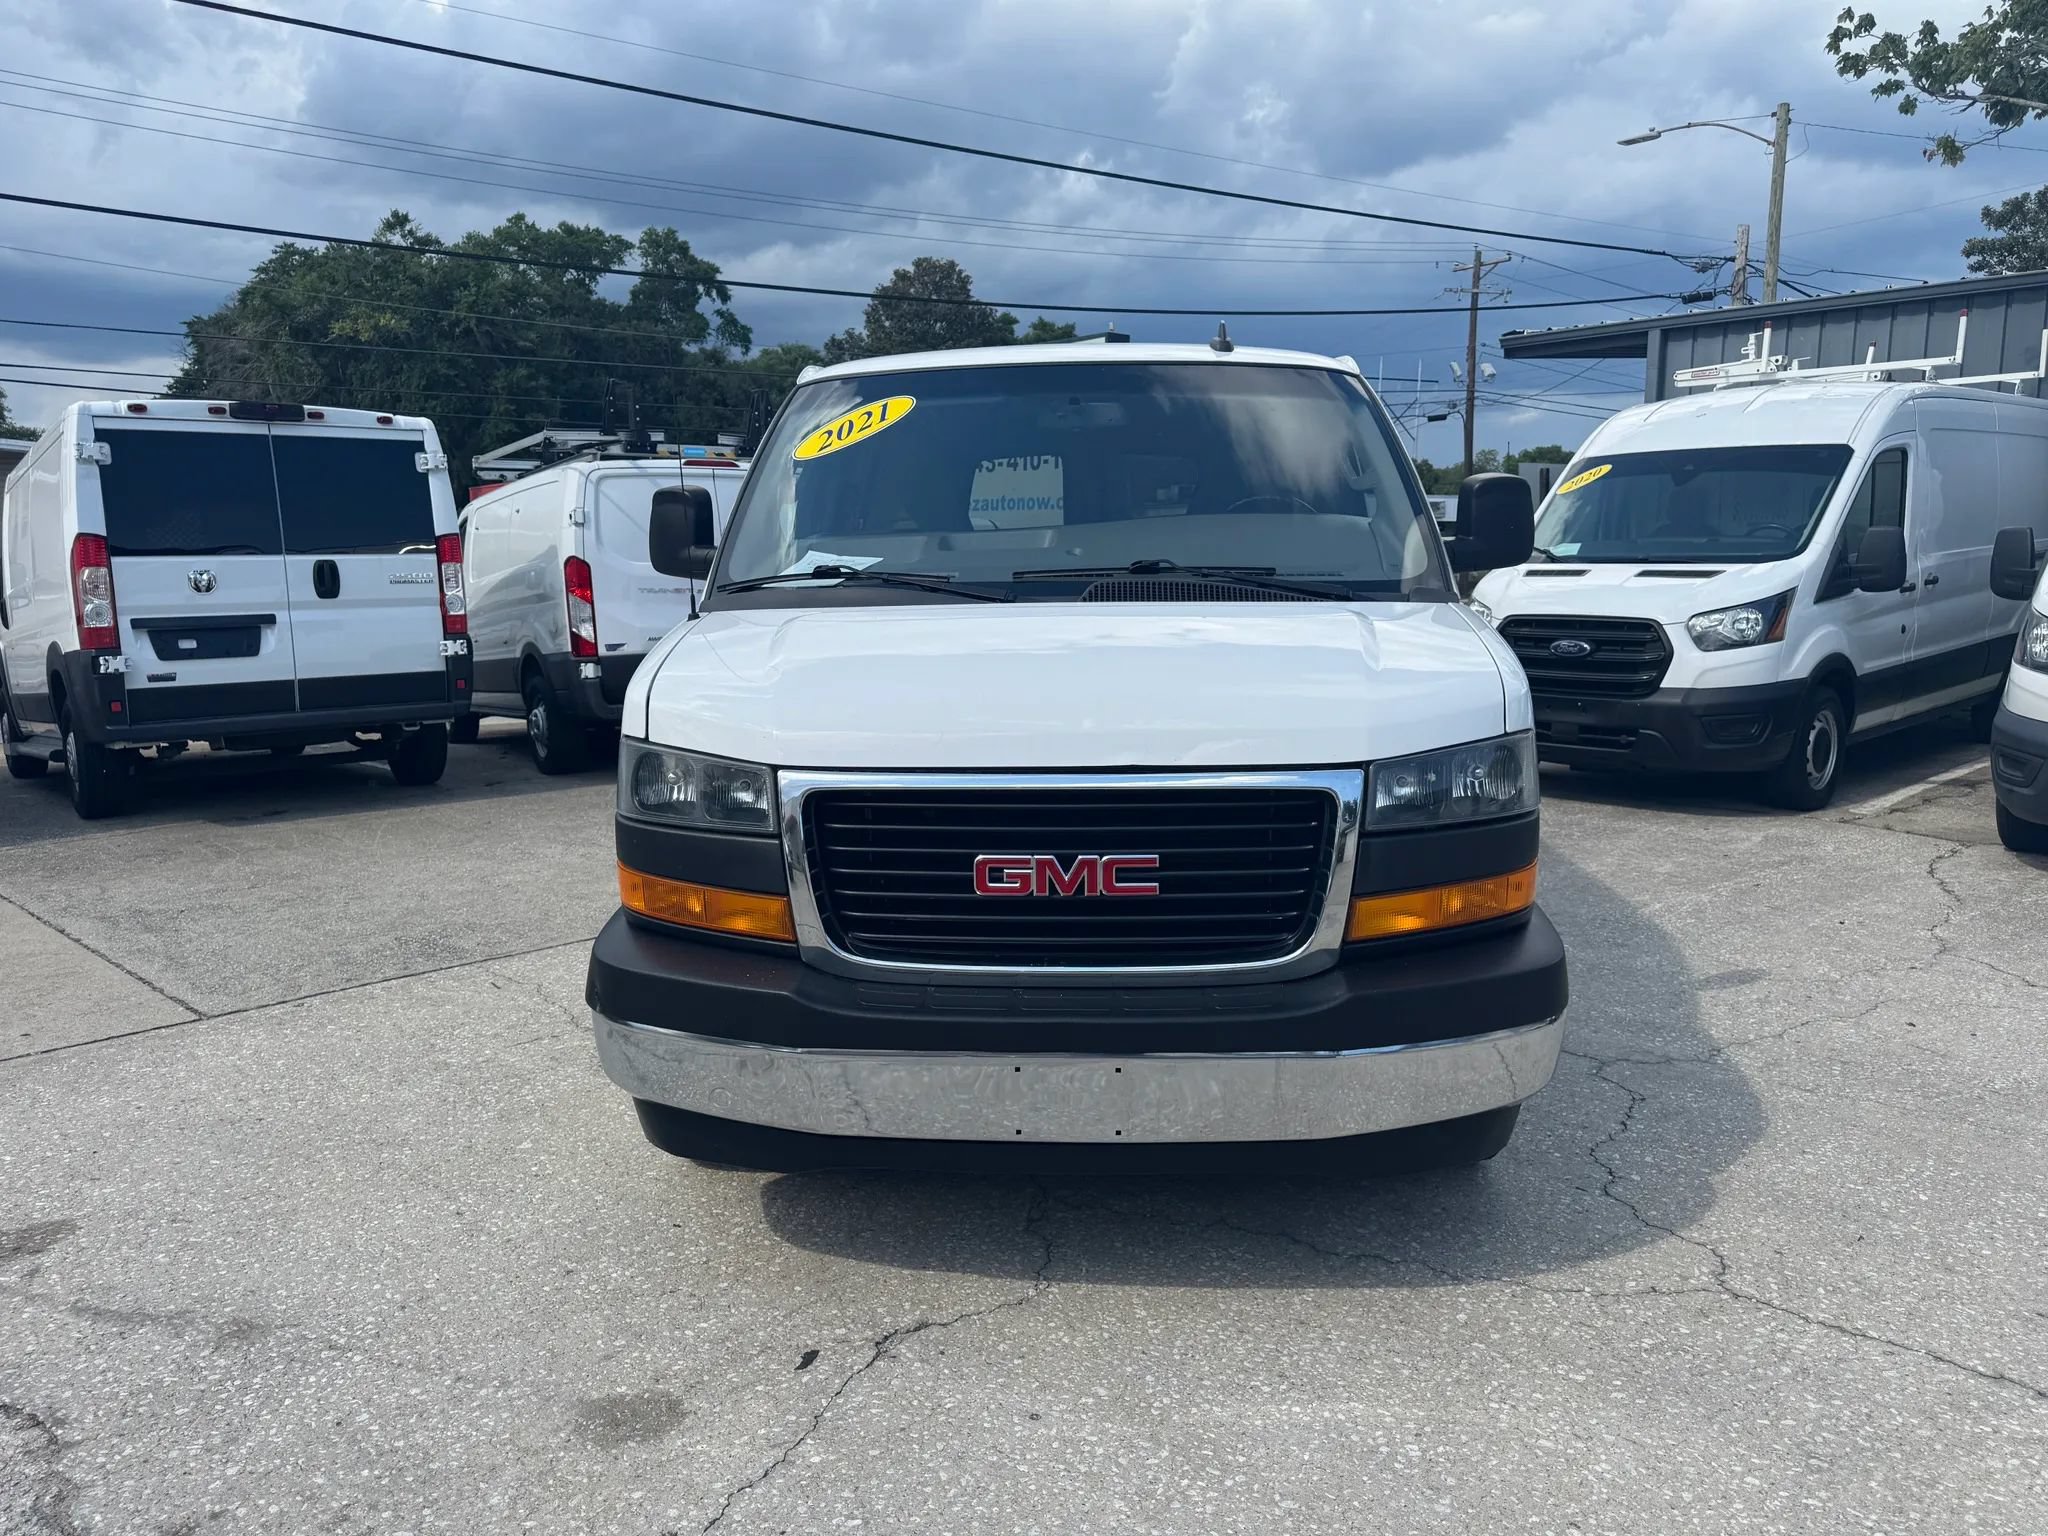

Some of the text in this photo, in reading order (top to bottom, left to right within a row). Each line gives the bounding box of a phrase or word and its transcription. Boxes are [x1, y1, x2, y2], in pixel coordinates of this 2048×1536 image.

[817, 402, 890, 453] 2021
[1566, 467, 1603, 491] 2020
[973, 854, 1160, 897] GMC
